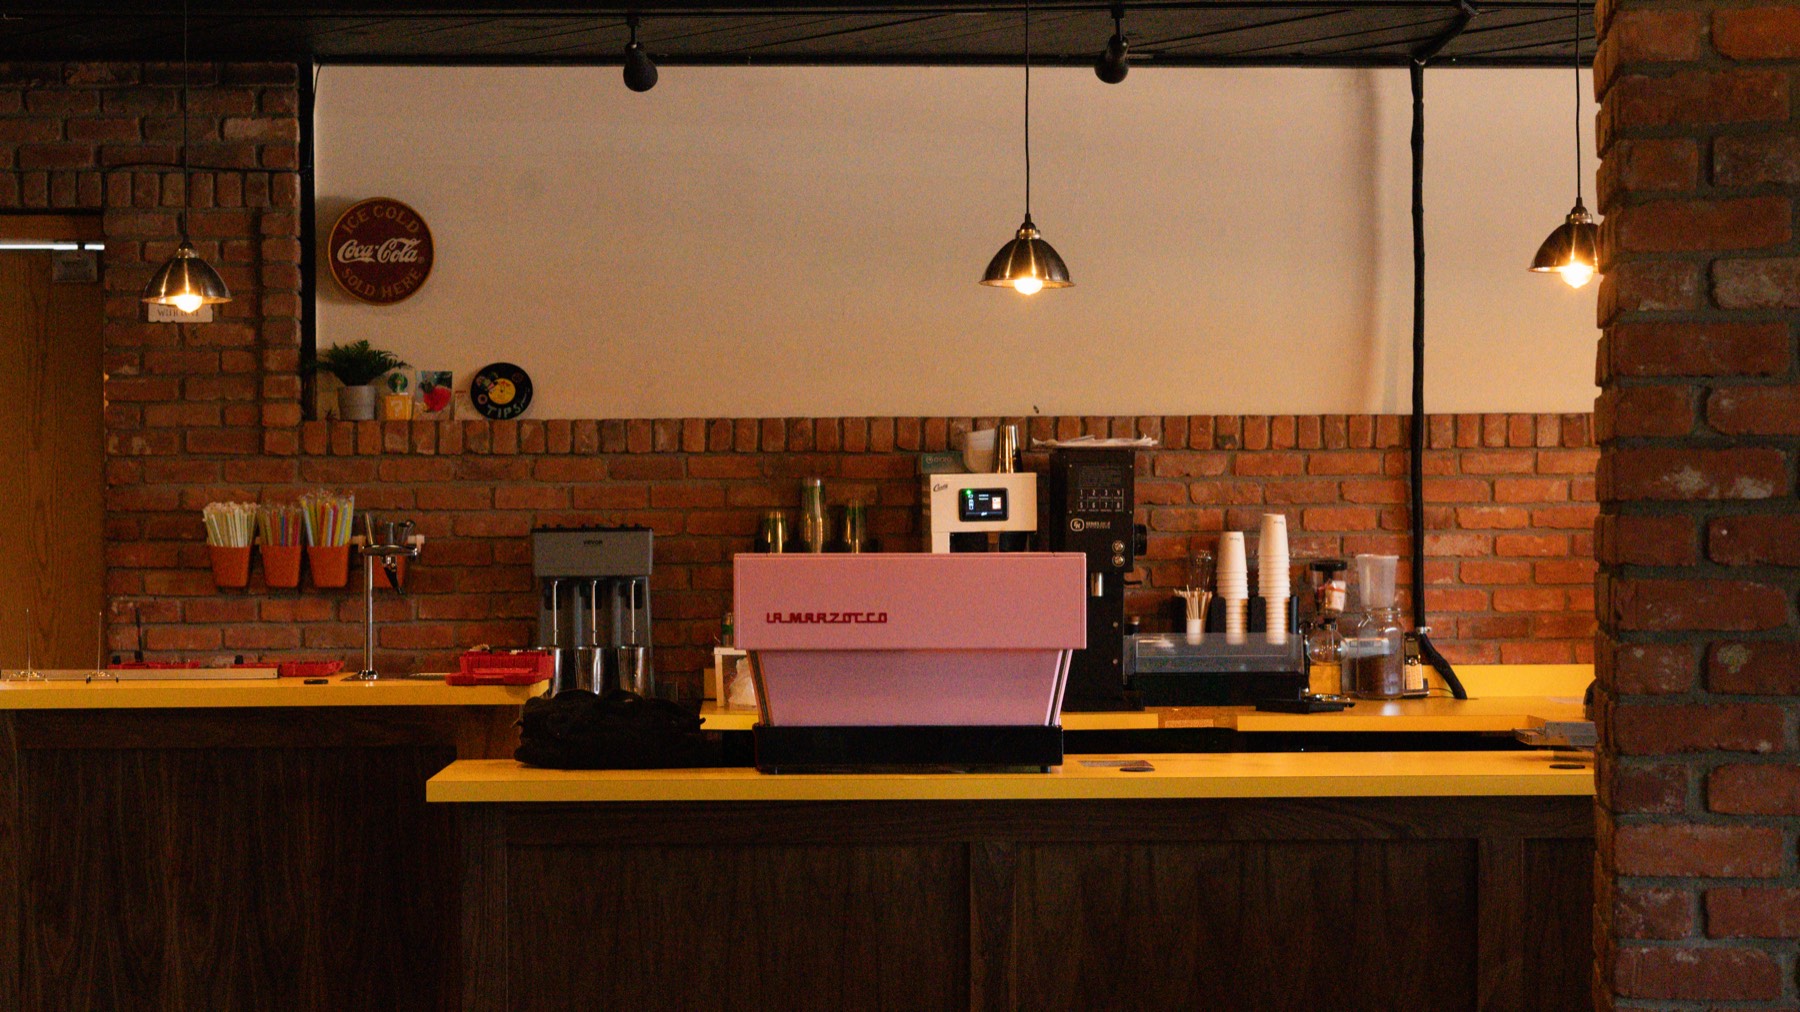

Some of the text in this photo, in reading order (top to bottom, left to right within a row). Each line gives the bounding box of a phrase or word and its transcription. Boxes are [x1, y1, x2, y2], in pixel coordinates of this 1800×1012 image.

[342, 205, 420, 234] ICE COLD
[337, 238, 421, 264] Coca-Cola
[342, 267, 421, 297] SOLD HERE
